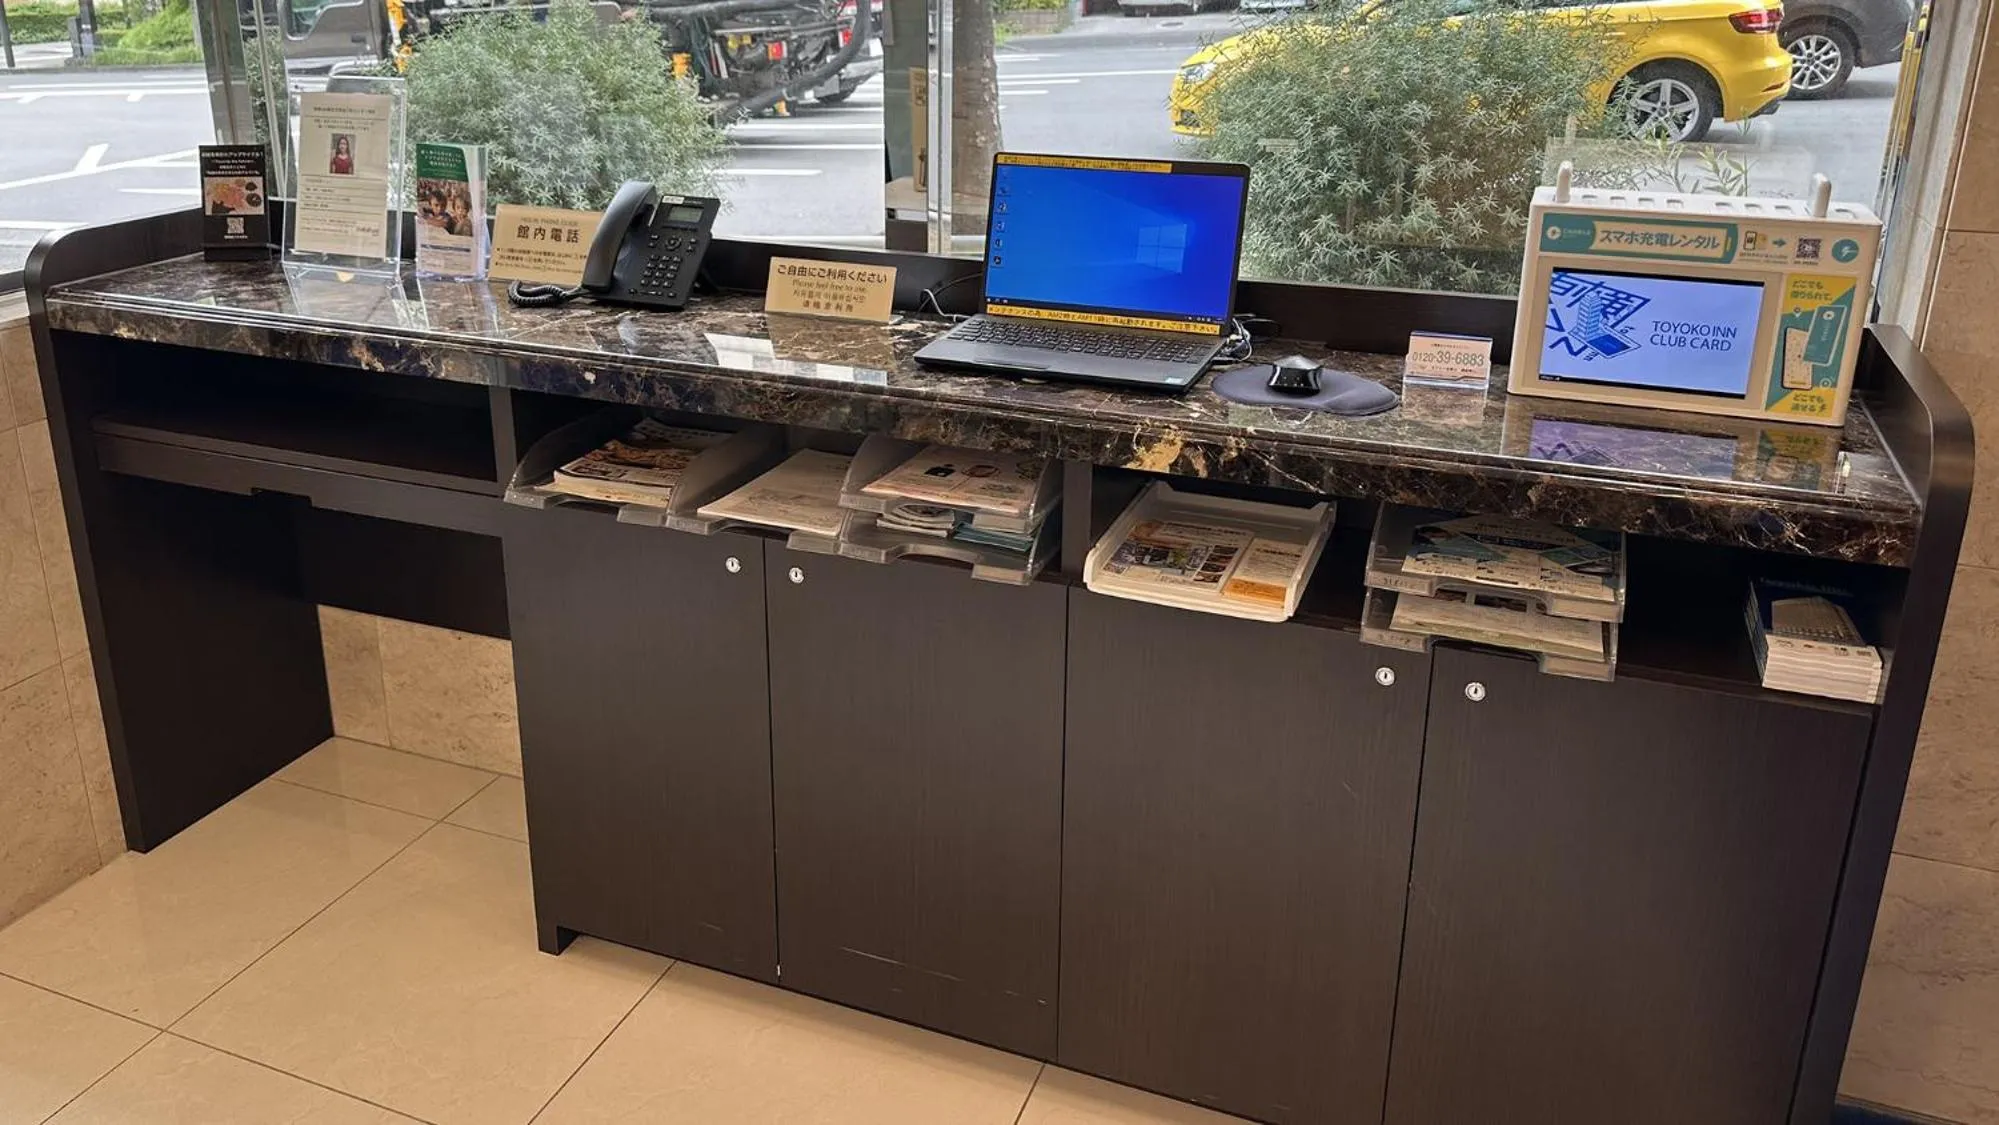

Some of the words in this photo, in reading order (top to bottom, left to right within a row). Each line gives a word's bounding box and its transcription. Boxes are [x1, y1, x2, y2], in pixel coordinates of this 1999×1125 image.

[517, 225, 578, 243] 館内電話
[1600, 229, 1720, 249] スマホ充電レンタル
[778, 264, 887, 283] ご自由にご利用ください
[1653, 321, 1711, 336] TOYOKO
[1712, 326, 1737, 338] INN
[1650, 334, 1687, 347] CLUB
[1690, 337, 1732, 351] CARD
[1412, 350, 1485, 366] 0120-39-6883
